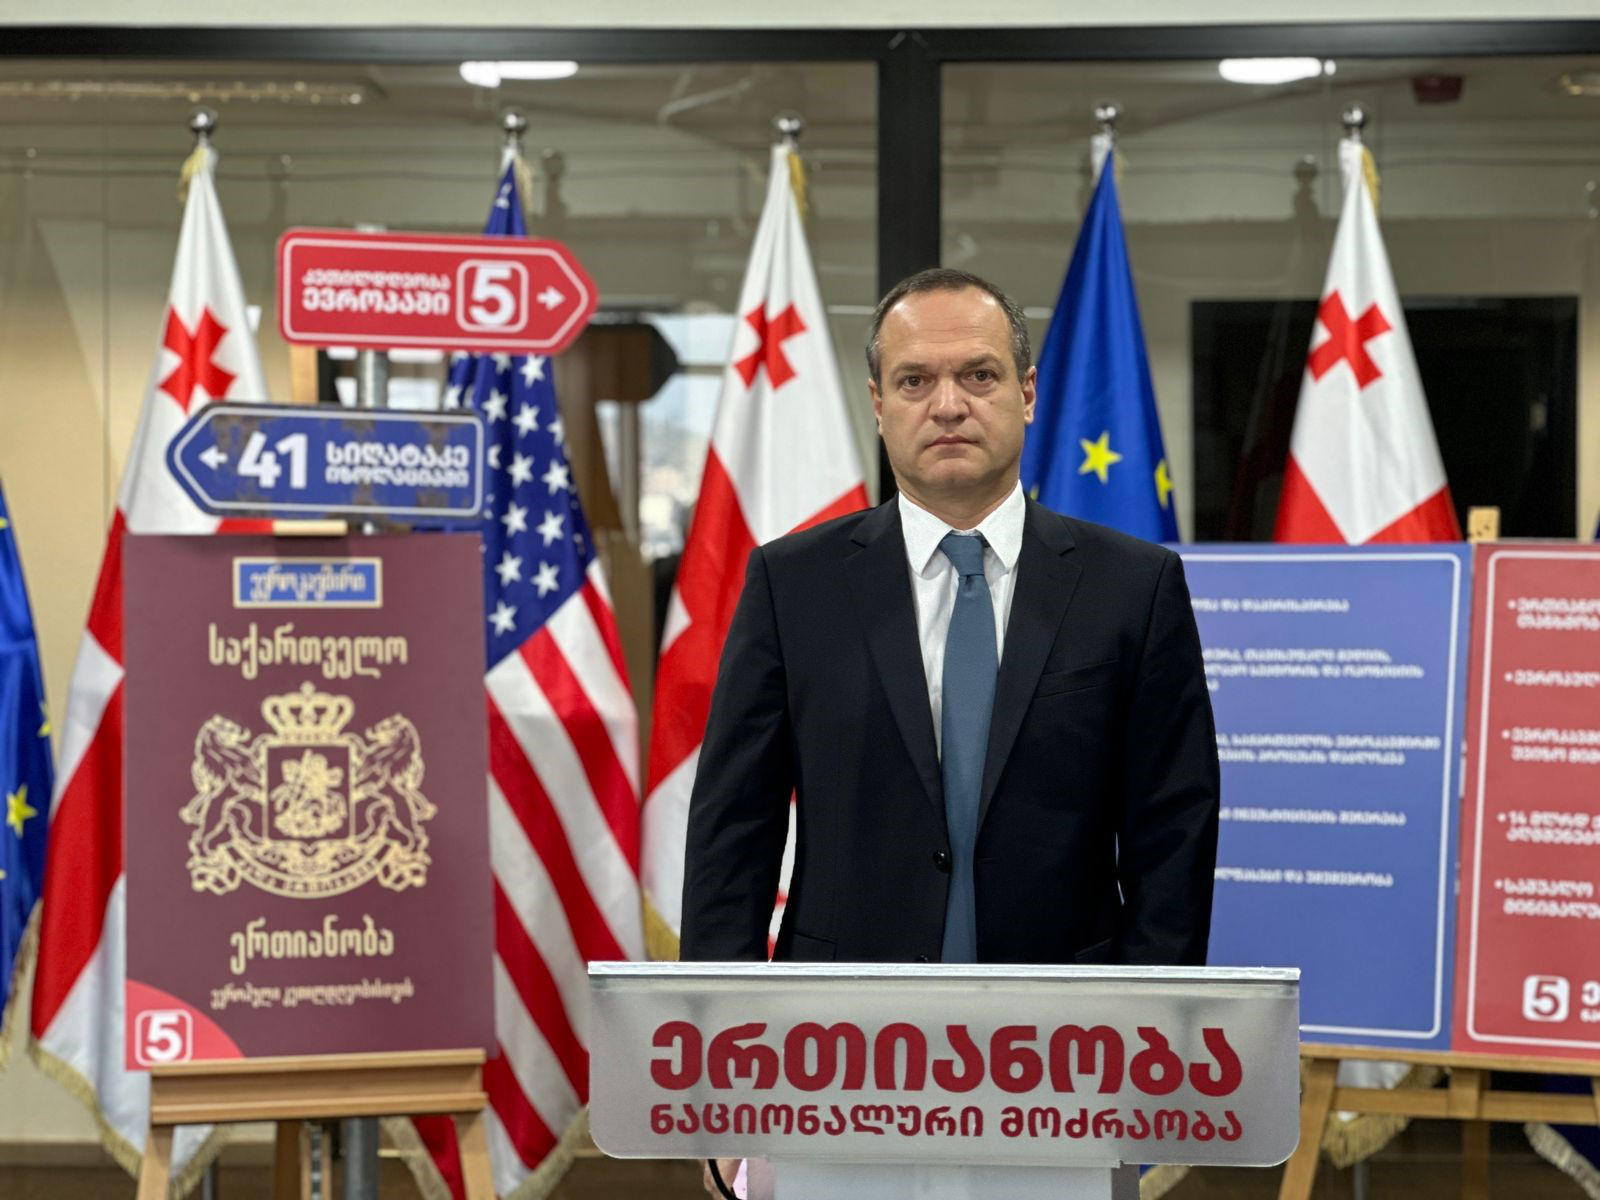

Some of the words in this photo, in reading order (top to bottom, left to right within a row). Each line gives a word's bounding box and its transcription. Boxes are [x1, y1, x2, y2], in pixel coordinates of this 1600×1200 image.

[302, 286, 450, 315] ევროპაში
[469, 264, 516, 326] 5
[237, 431, 308, 489] 41
[325, 440, 470, 468] სიღატაკე
[208, 622, 408, 679] საქართველო
[230, 914, 395, 975] ერთიანობა
[145, 1012, 183, 1062] 5
[650, 1020, 1243, 1096] ერთიანობა
[650, 1102, 984, 1137] ნაციონალური
[1000, 1106, 1243, 1141] მოძრაობა
